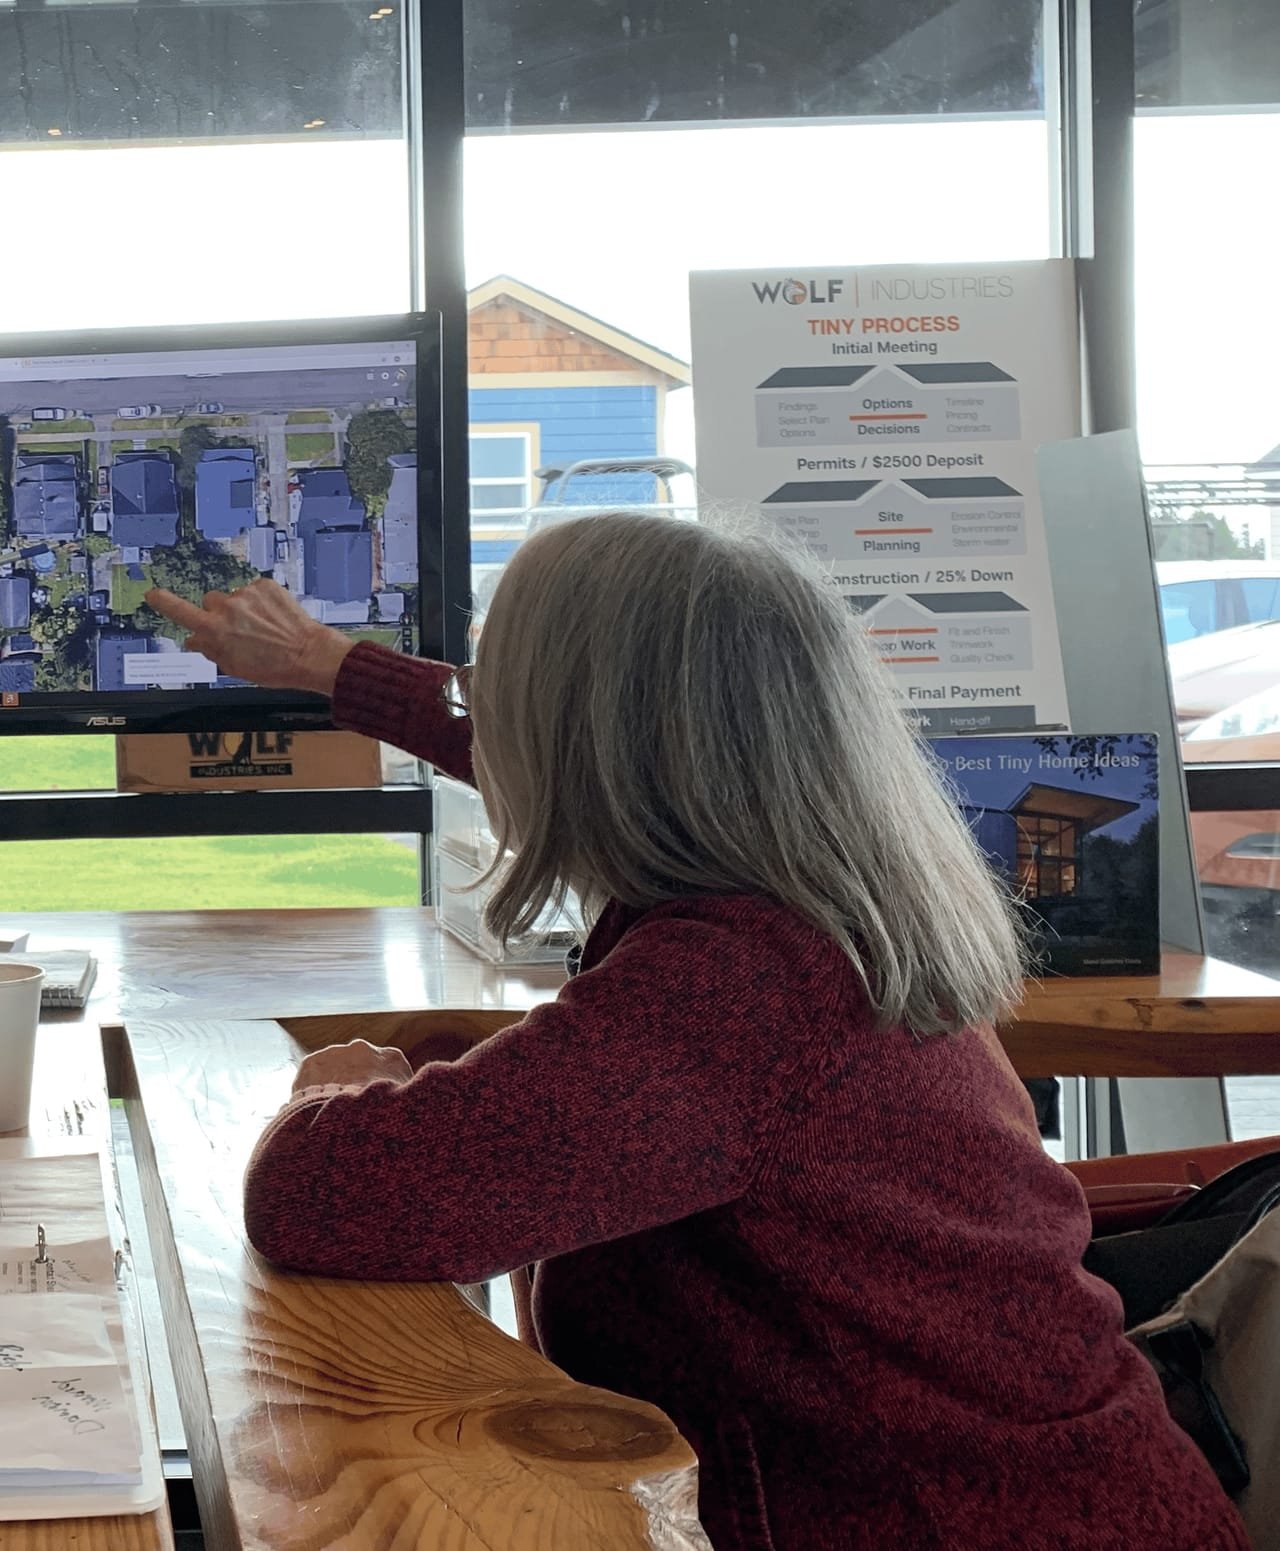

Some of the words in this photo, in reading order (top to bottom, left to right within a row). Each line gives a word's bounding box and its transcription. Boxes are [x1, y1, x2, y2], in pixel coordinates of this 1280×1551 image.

[871, 275, 1014, 301] INDUSTRIES
[808, 319, 854, 335] TINY
[862, 316, 960, 334] PROCESS
[832, 342, 873, 355] Initial
[878, 340, 938, 355] Meeting
[862, 398, 913, 411] Options
[858, 423, 920, 435] Decisions
[797, 457, 856, 470] Permits
[861, 456, 868, 469] /
[872, 455, 922, 469] $2500
[926, 453, 984, 469] Deposit
[878, 511, 904, 522] Site
[863, 540, 920, 552] Planning
[924, 571, 931, 584] /
[936, 571, 967, 583] 25%
[971, 569, 1014, 582] Down
[901, 639, 936, 650] Work
[908, 686, 946, 700] Final
[951, 684, 1022, 701] Payment
[86, 716, 127, 726] ASUS
[998, 754, 1033, 773] Tiny
[1039, 754, 1089, 769] Home
[1094, 752, 1140, 768] Ideas
